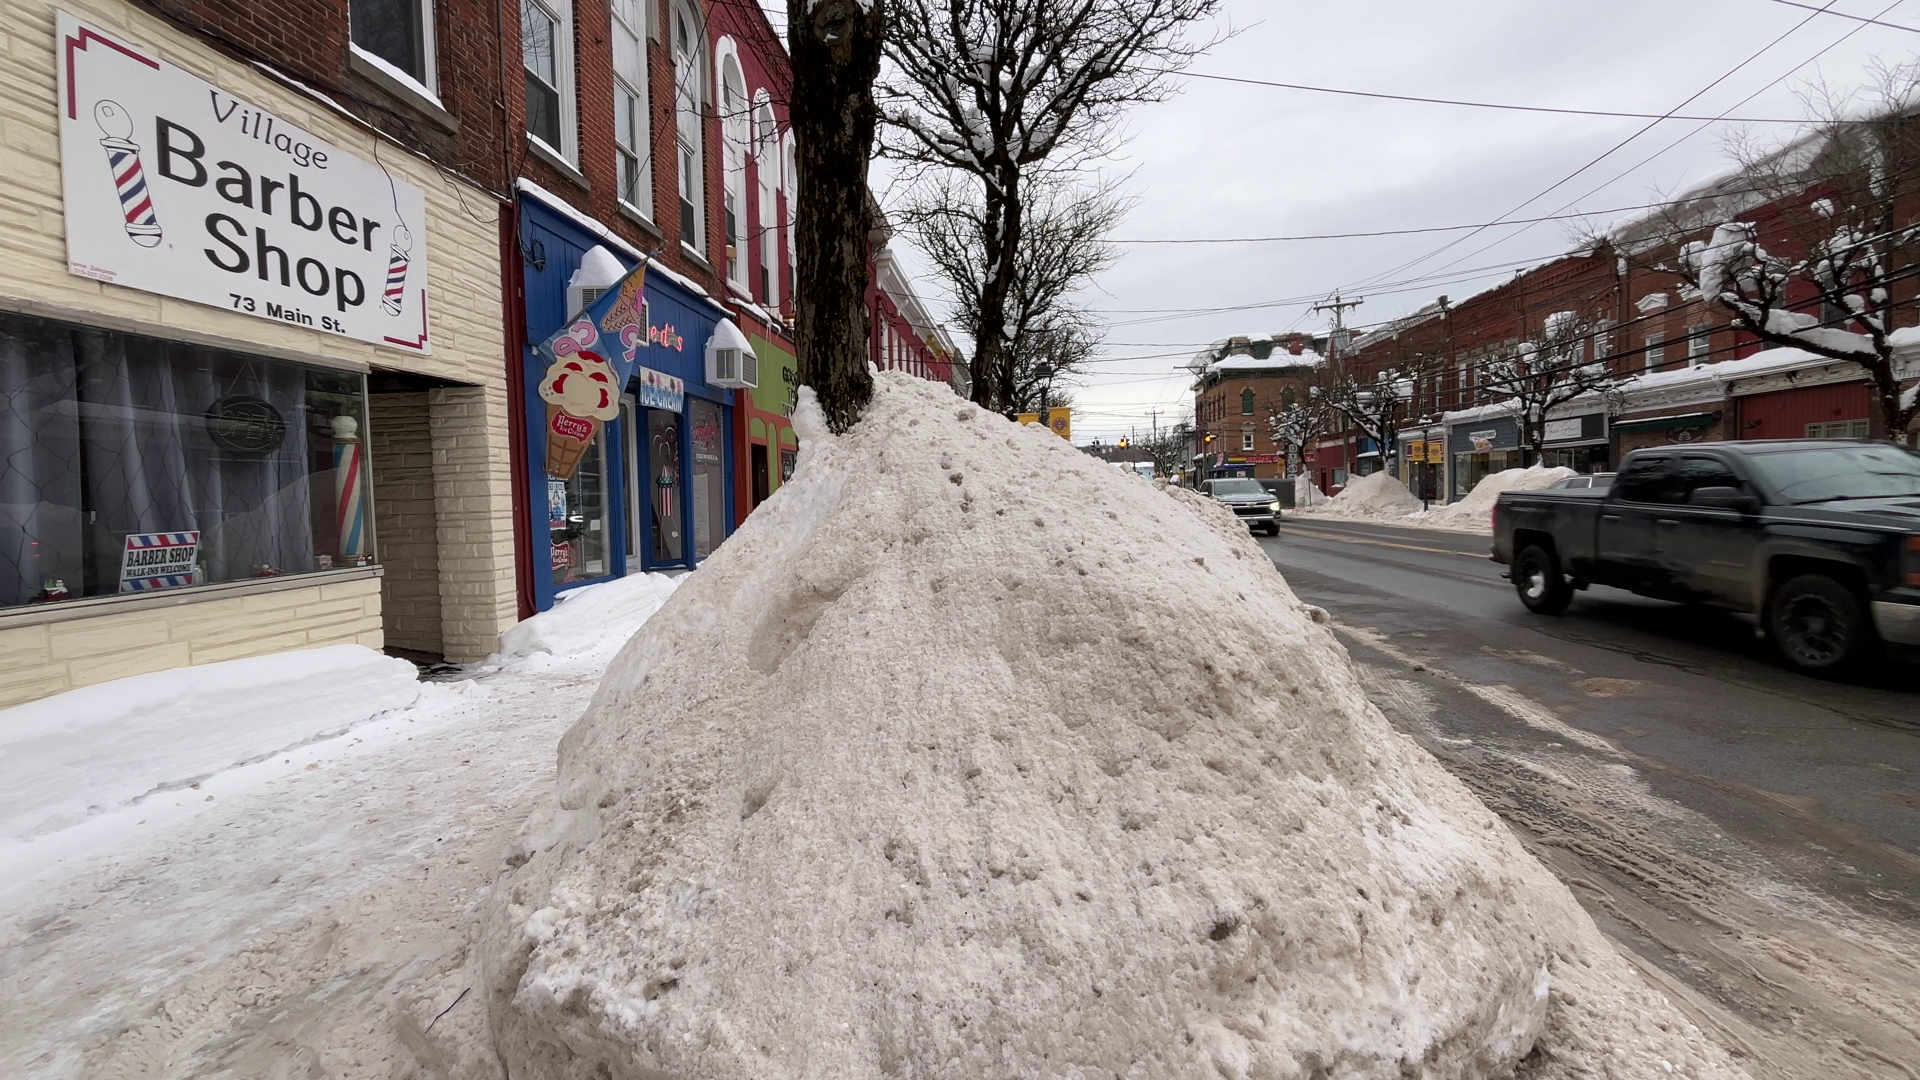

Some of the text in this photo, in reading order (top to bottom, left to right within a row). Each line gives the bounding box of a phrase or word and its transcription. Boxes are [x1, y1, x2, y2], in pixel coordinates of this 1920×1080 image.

[210, 89, 328, 169] Village
[156, 116, 381, 251] Barber
[204, 213, 365, 312] Shop
[229, 293, 345, 333] 73 Main St.
[640, 385, 683, 413] ICE CREAM
[216, 410, 278, 441] OPEN
[557, 415, 588, 432] Perry's
[567, 428, 585, 438] Cream
[126, 547, 194, 568] BARBER SHOP
[126, 564, 191, 578] WALK-INS WELCOME
